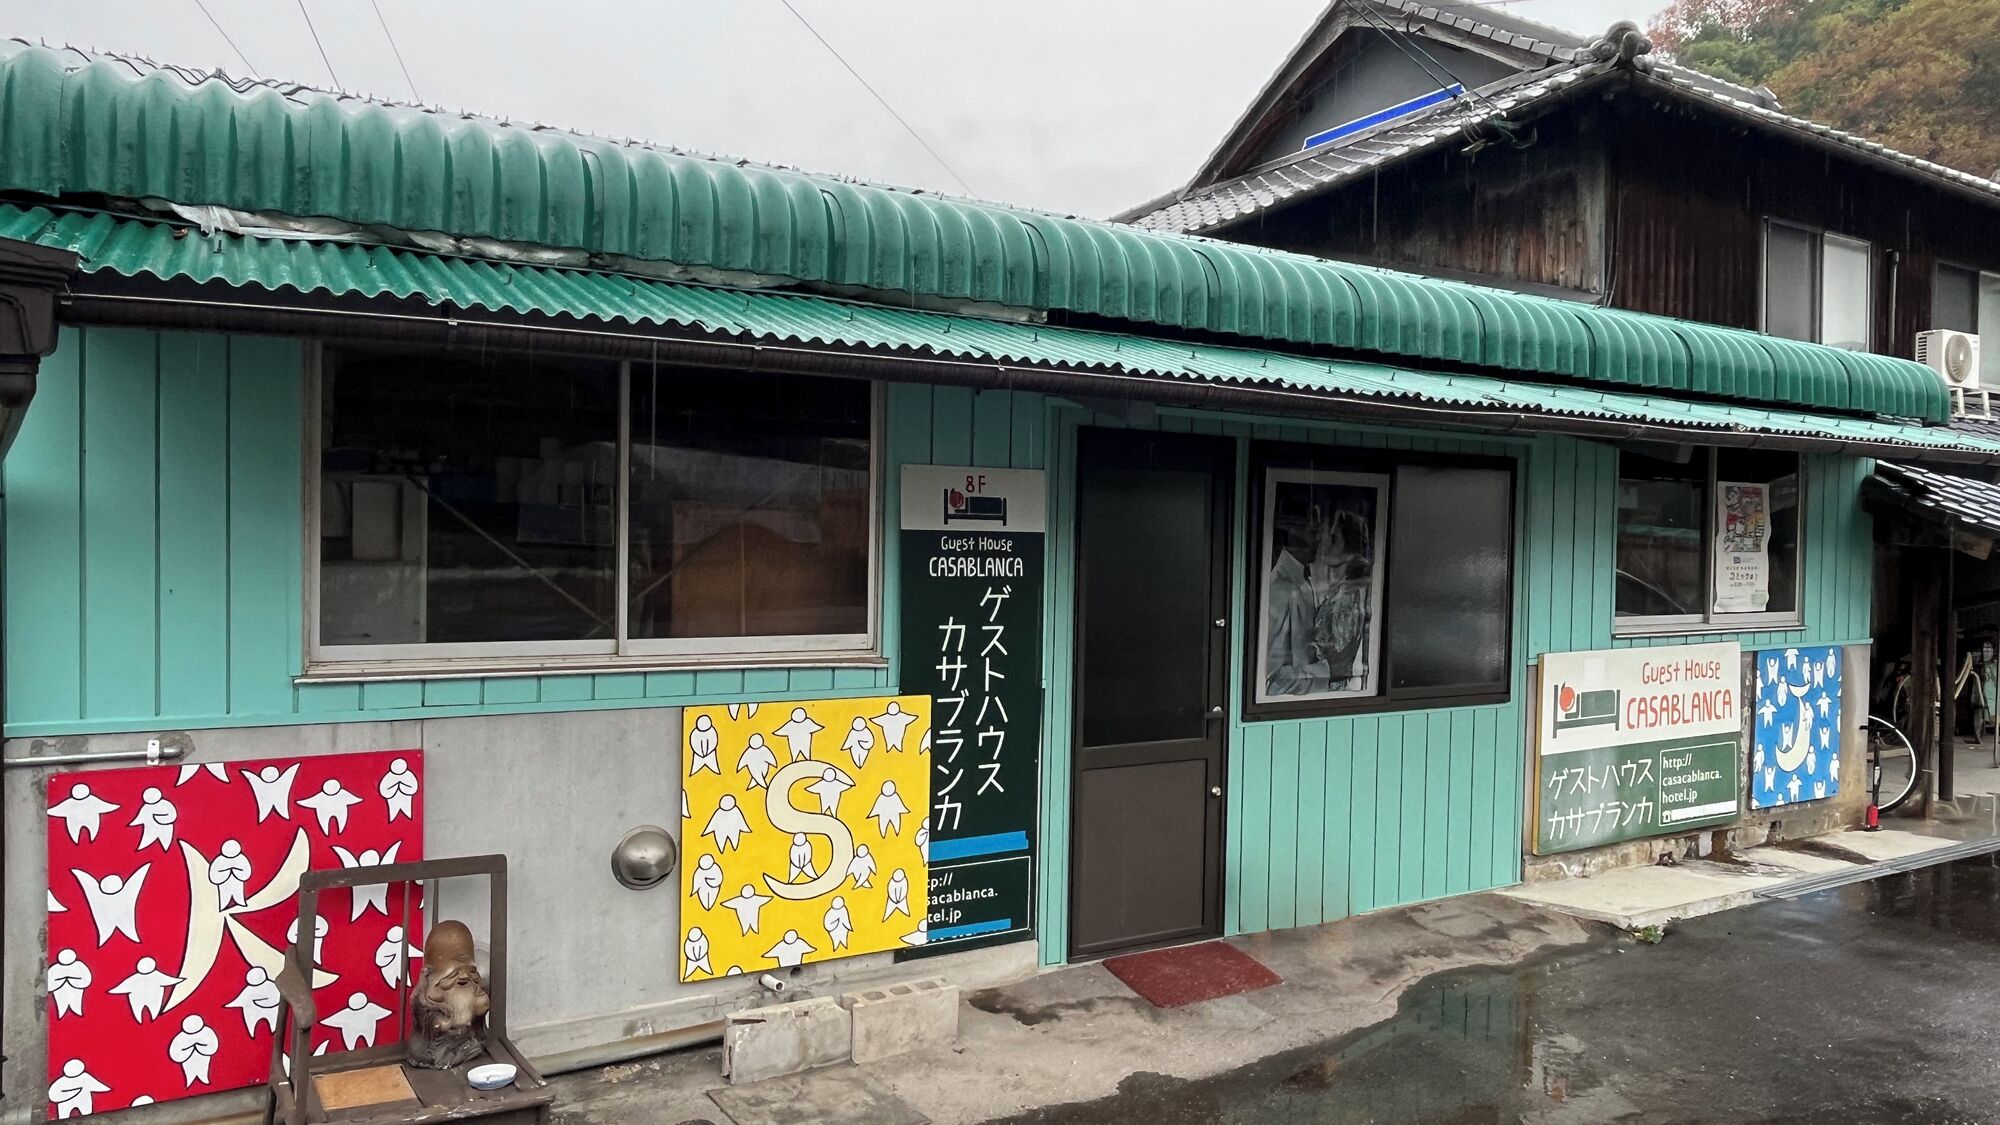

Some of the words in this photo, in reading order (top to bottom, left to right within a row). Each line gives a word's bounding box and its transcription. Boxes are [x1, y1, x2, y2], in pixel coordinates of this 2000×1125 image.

[941, 535, 975, 552] Guest
[979, 536, 1013, 552] House
[929, 556, 1023, 577] CASABLANCA
[1642, 661, 1680, 685] Guest
[1685, 659, 1721, 681] House
[975, 584, 1011, 796] ゲストハウス
[1627, 689, 1732, 730] CASABLANCA
[933, 616, 970, 832] カサブランカ
[1662, 753, 1693, 771] http://
[1548, 758, 1654, 800] ゲストハウス
[1662, 769, 1722, 787] casacablanca.
[1662, 788, 1698, 804] hotel.jp
[1548, 796, 1653, 840] カサブランカ
